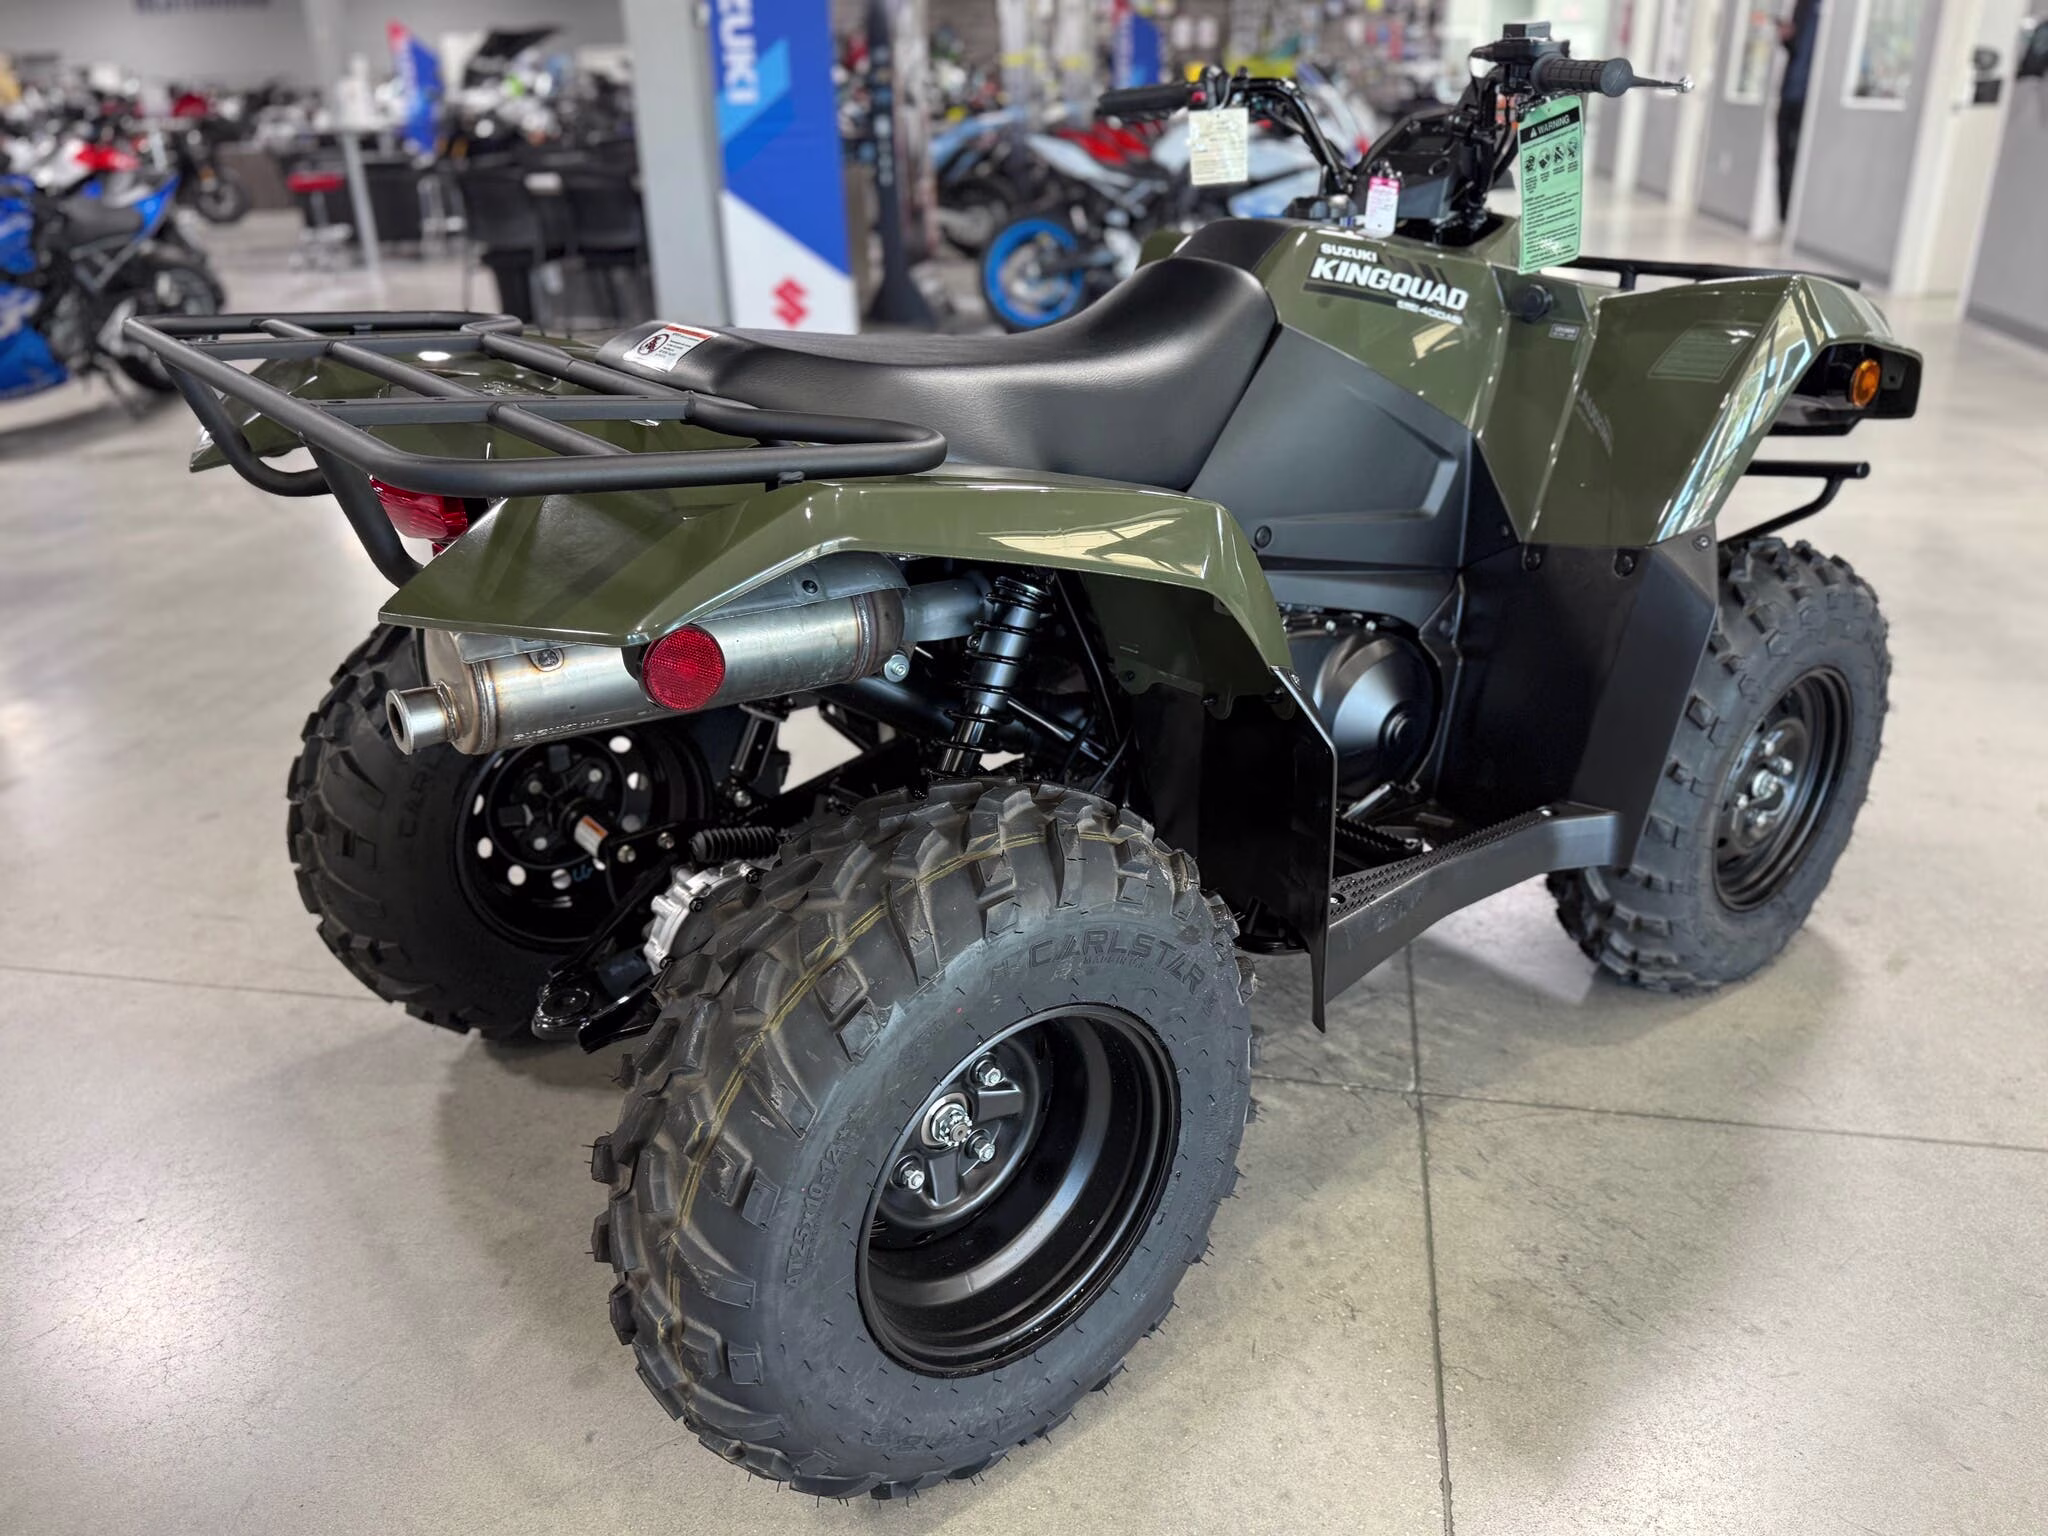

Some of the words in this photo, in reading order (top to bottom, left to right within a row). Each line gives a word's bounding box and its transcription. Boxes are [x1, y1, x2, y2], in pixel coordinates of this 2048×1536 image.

[1537, 114, 1570, 136] WARNING
[1319, 242, 1378, 263] SUZUKI
[1310, 256, 1470, 311] KINGQUAD
[1028, 928, 1206, 995] CARLSTAR
